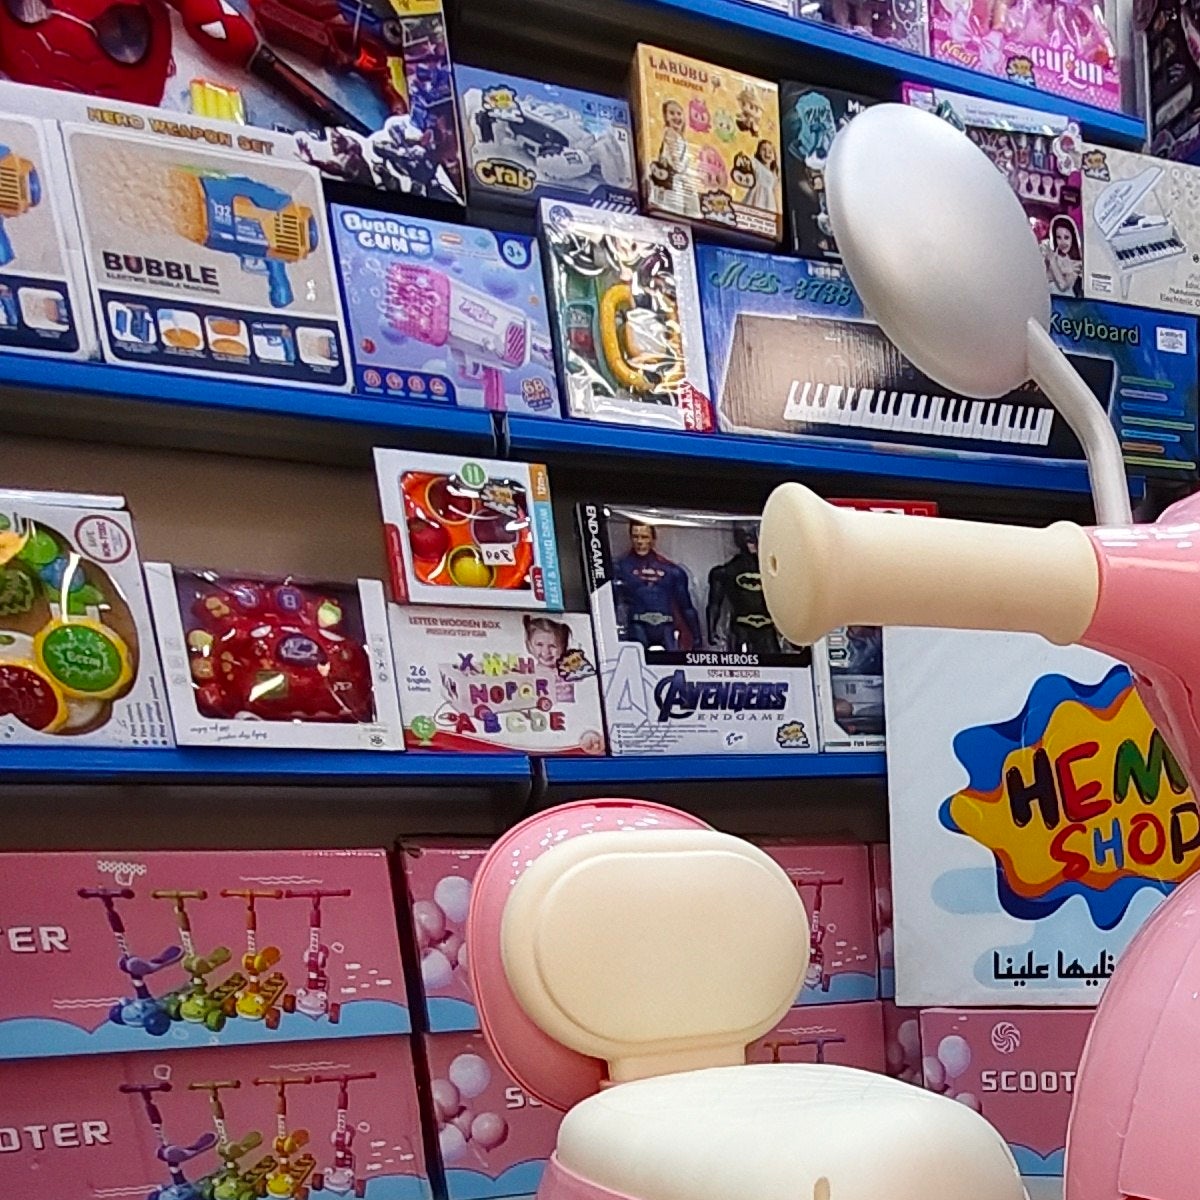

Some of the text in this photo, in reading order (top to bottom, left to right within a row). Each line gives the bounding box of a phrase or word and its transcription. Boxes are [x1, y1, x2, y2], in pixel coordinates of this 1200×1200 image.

[649, 55, 708, 83] LABUBU
[87, 107, 274, 155] HERO WEAPON SET
[476, 161, 533, 190] Crab
[343, 212, 431, 243] BUBBLES
[358, 231, 409, 253] GUN
[506, 244, 522, 260] 3+
[103, 251, 220, 288] BUBBLE
[523, 379, 545, 395] 68
[585, 505, 605, 579] END-GAME
[409, 616, 438, 626] LETTER
[482, 620, 501, 629] BOX
[410, 666, 426, 676] 26
[686, 653, 759, 665] SUPER HEROES
[698, 713, 785, 721] ENDGAME
[0, 926, 70, 952] ER
[993, 949, 1050, 986] علينا
[981, 1070, 1076, 1092] SCOOT
